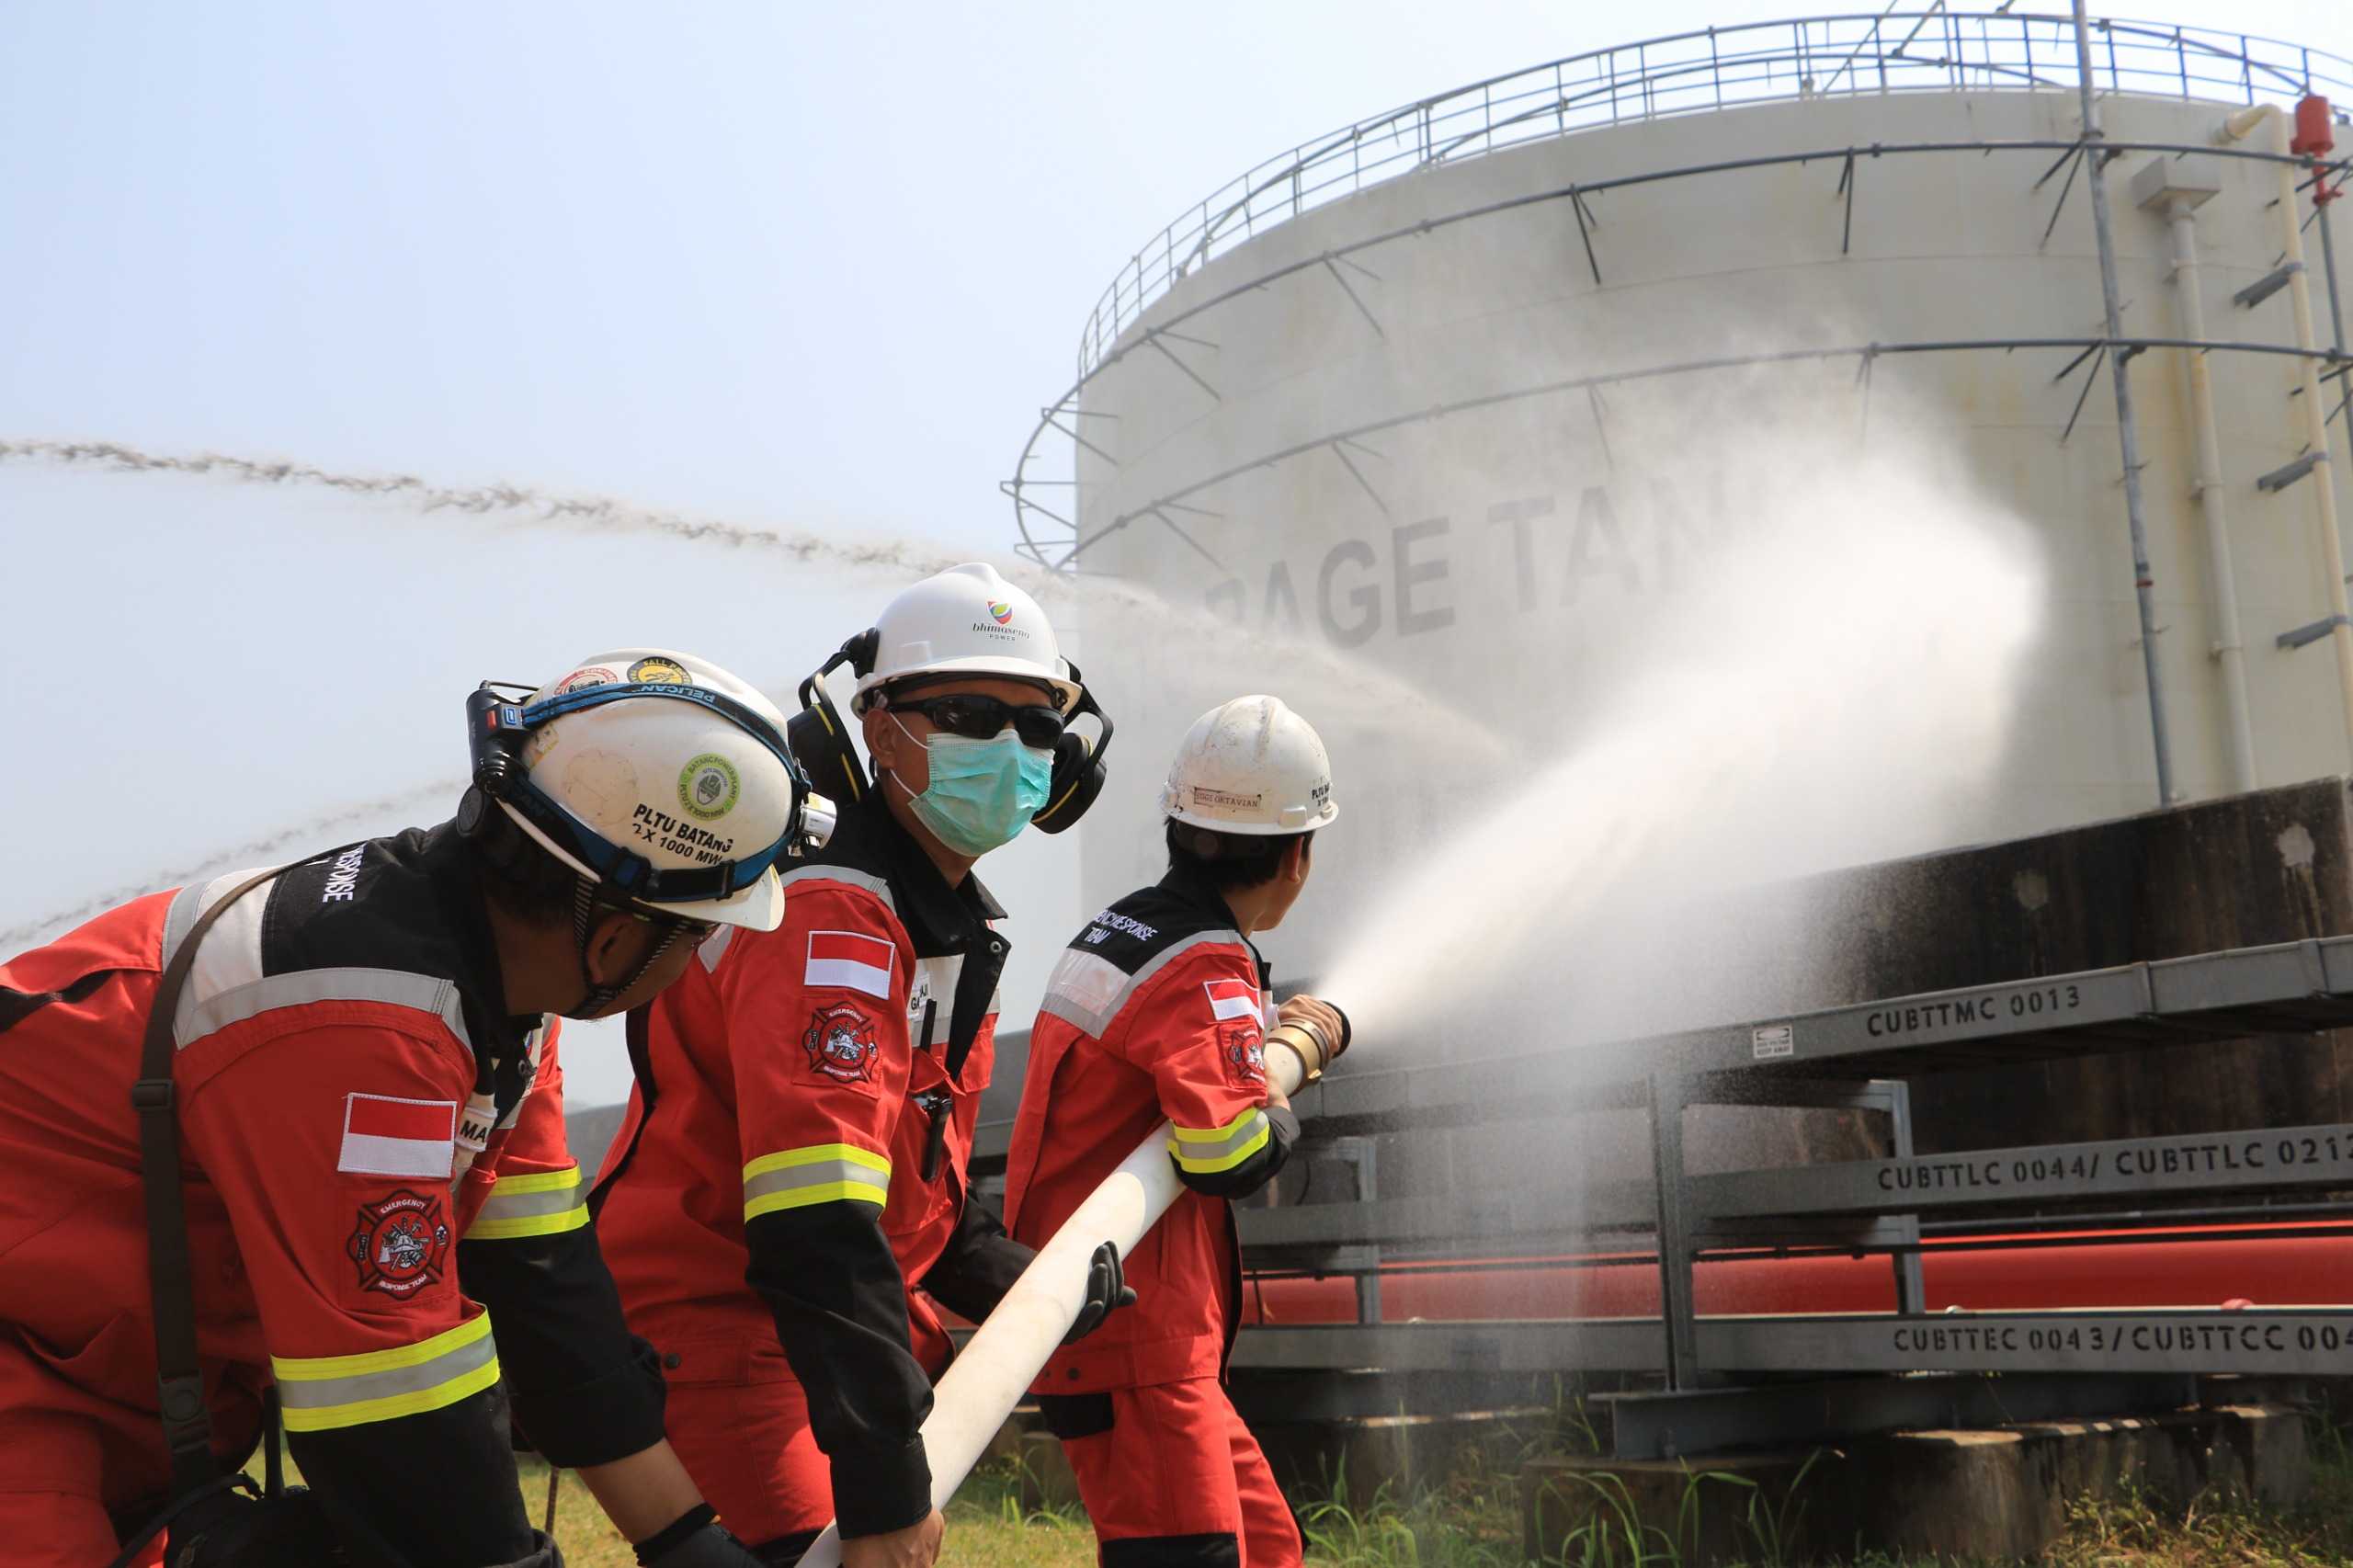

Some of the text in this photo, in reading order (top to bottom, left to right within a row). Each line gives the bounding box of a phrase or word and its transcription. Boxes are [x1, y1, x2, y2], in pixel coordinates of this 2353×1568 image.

[633, 803, 677, 834] PLTU
[632, 823, 723, 866] 2 X 1000 MW
[1867, 985, 2080, 1037] CUBTTMC 0013
[1878, 1162, 2001, 1191] CUBTTLC
[2115, 1142, 2265, 1176] CUBTTLC
[380, 1199, 426, 1214] EMERGENCY
[1893, 1327, 2018, 1351] CUBTTEC
